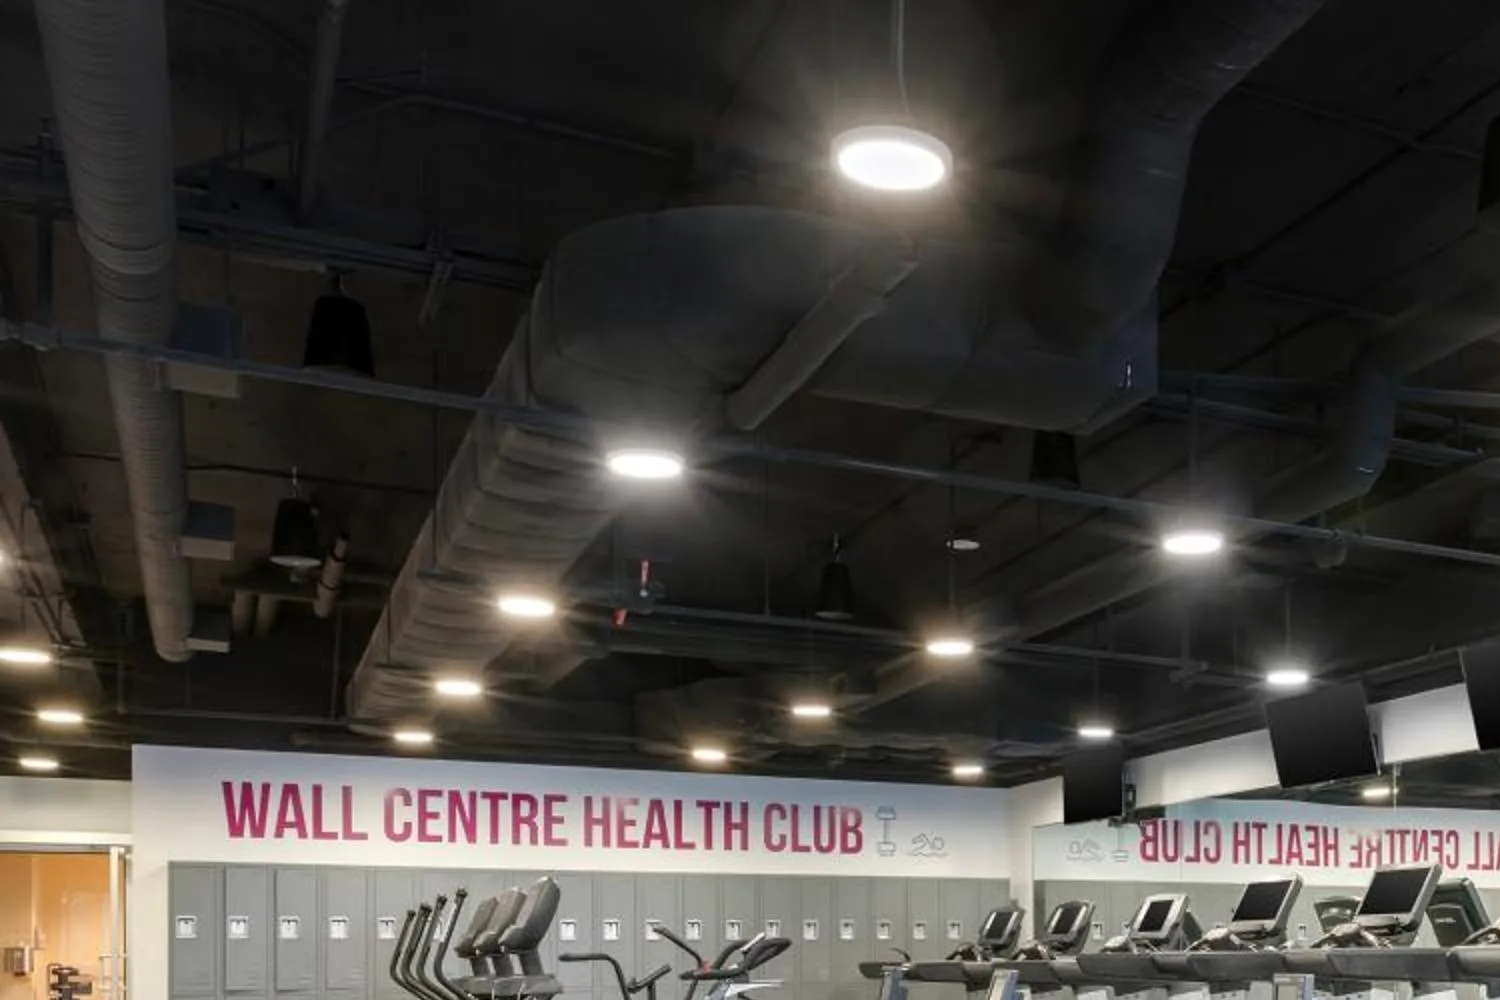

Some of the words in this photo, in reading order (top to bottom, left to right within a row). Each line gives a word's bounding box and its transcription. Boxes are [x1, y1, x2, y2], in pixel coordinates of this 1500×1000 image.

[221, 781, 369, 841] WALL
[382, 787, 569, 847] CENTRE
[583, 795, 750, 852] HEALTH
[763, 802, 863, 855] CLUB
